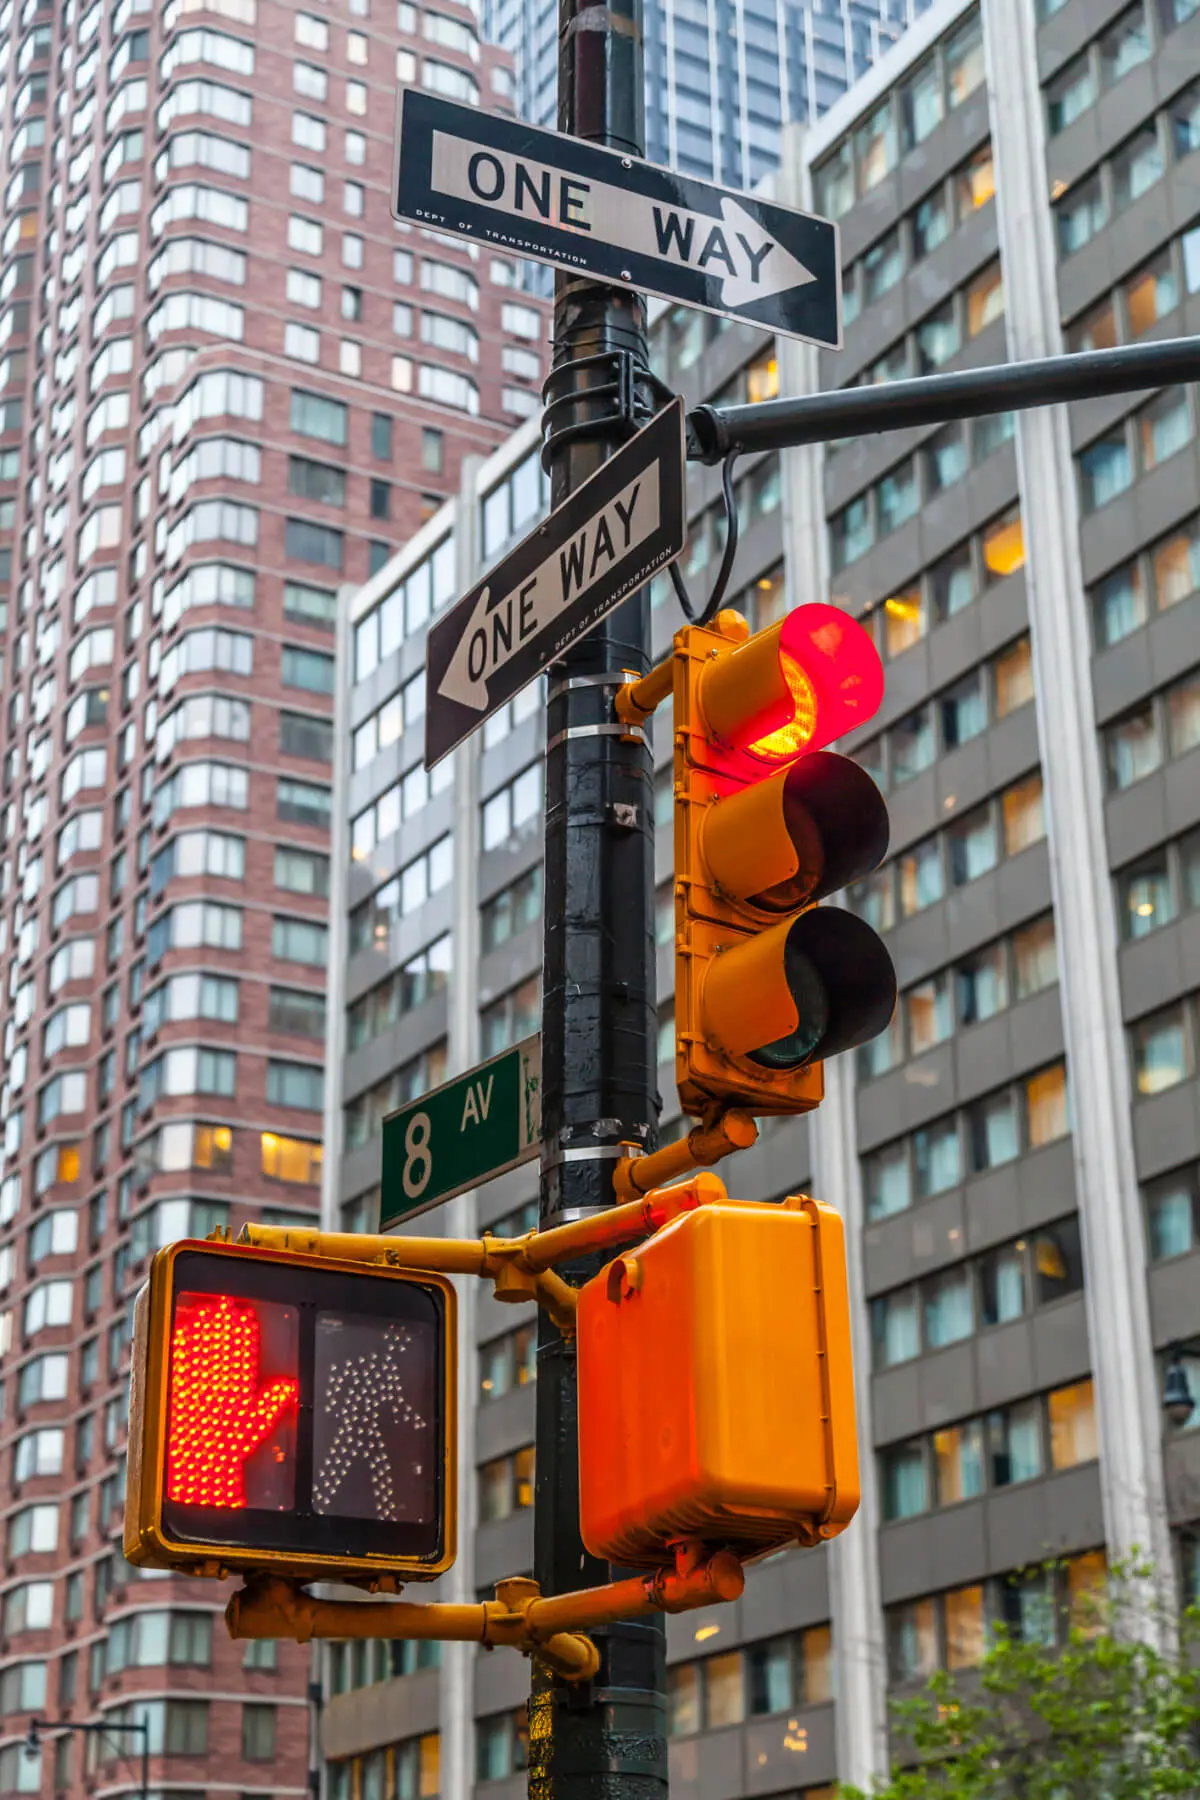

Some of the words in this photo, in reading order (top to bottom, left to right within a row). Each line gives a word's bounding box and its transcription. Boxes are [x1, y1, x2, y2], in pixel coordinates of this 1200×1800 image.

[416, 209, 446, 223] DEPT
[458, 222, 473, 231] OF
[486, 230, 588, 265] TRANSPORTATION
[468, 153, 591, 231] ONE
[652, 206, 774, 283] WAY
[468, 578, 537, 682] ONE
[559, 484, 640, 601] WAY
[555, 628, 576, 651] DEPT
[578, 616, 590, 630] OF
[593, 545, 672, 617] TRANSPORTATION
[403, 1112, 432, 1198] 8
[460, 1074, 494, 1132] AV
